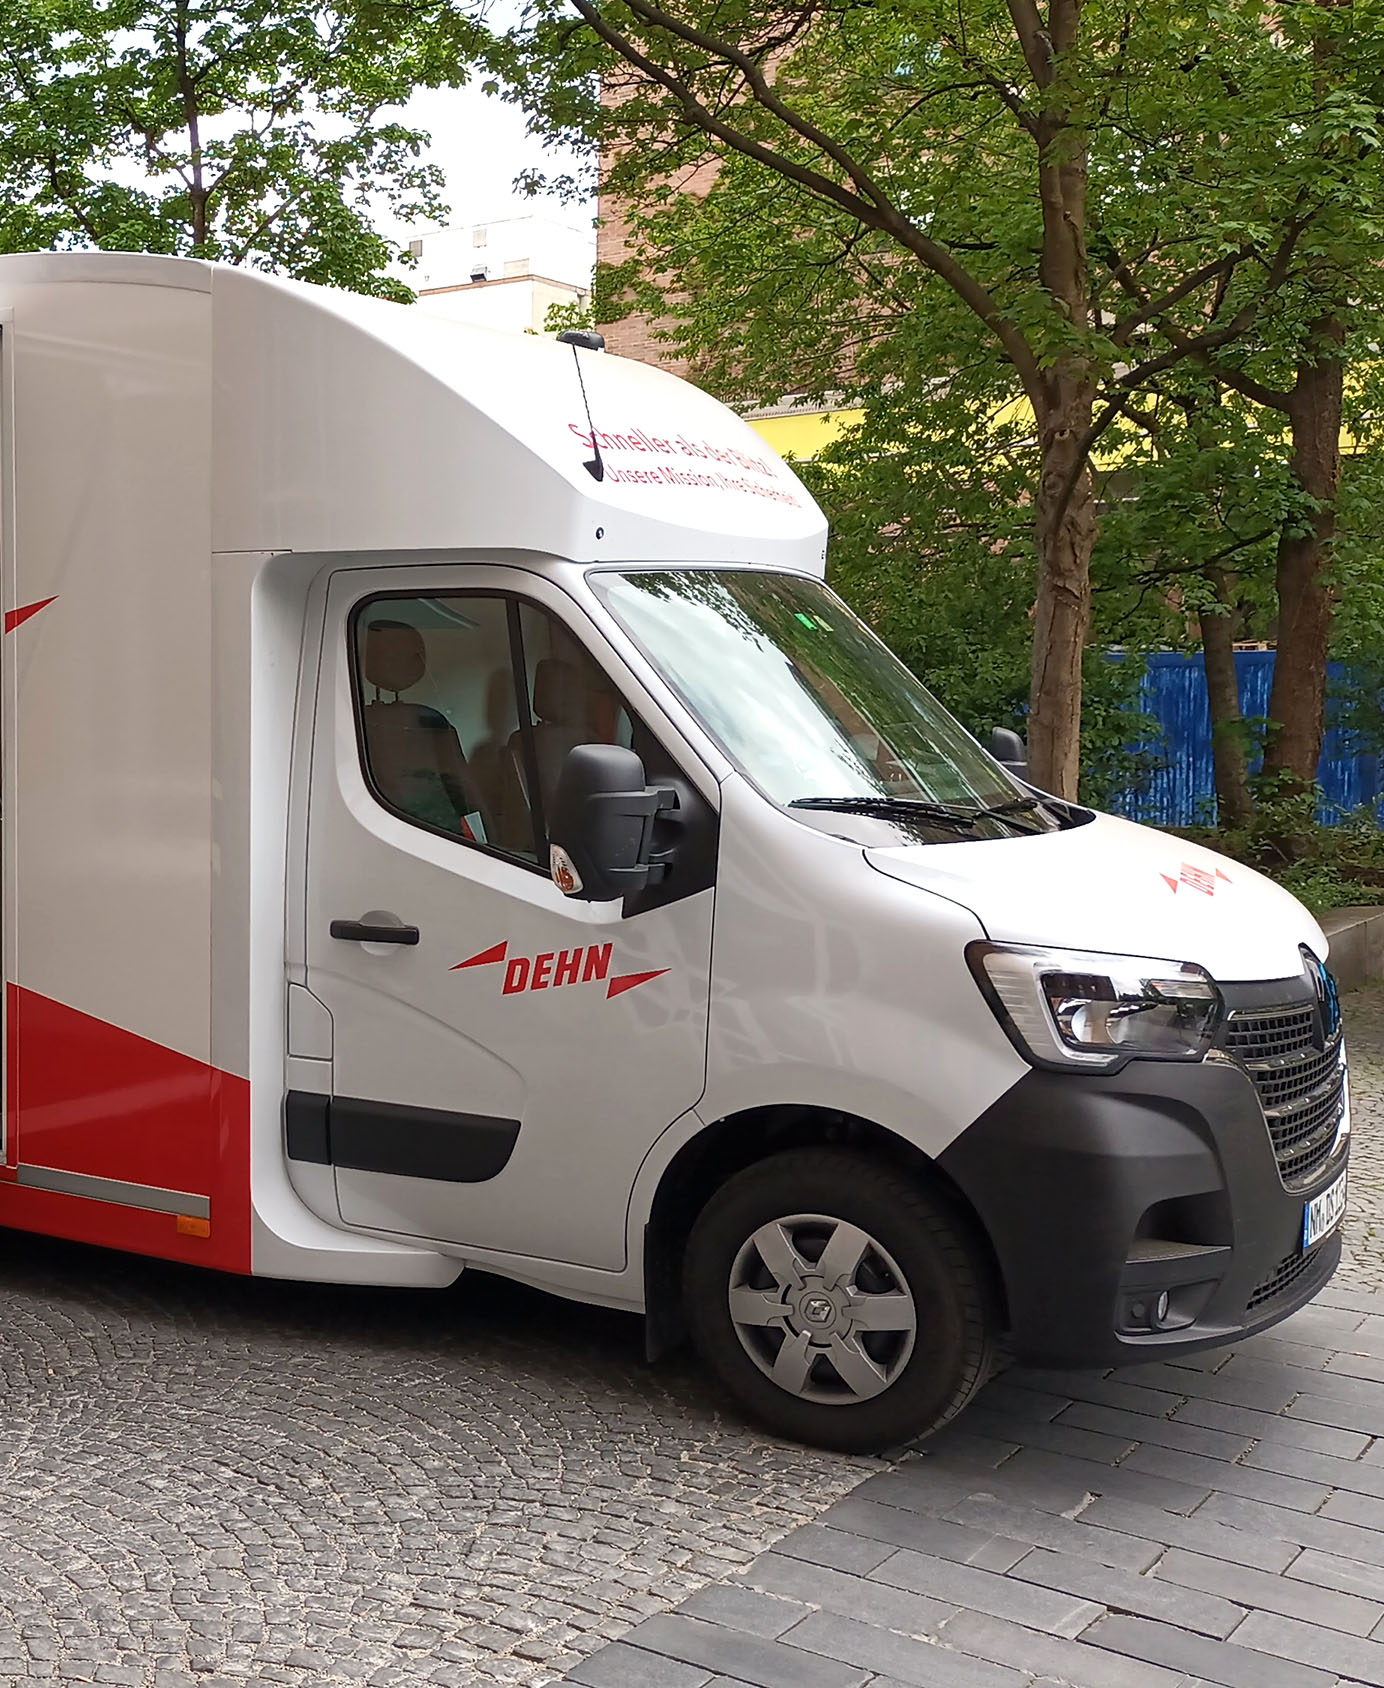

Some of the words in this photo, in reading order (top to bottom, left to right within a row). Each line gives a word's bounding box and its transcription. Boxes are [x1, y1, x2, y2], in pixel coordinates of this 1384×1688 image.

[568, 423, 677, 454] Schneller
[675, 434, 708, 459] als
[702, 440, 737, 466] der
[605, 463, 663, 484] Unsere
[657, 466, 724, 491] Mission,
[1180, 862, 1215, 896] DEHN
[502, 942, 613, 996] DEHN
